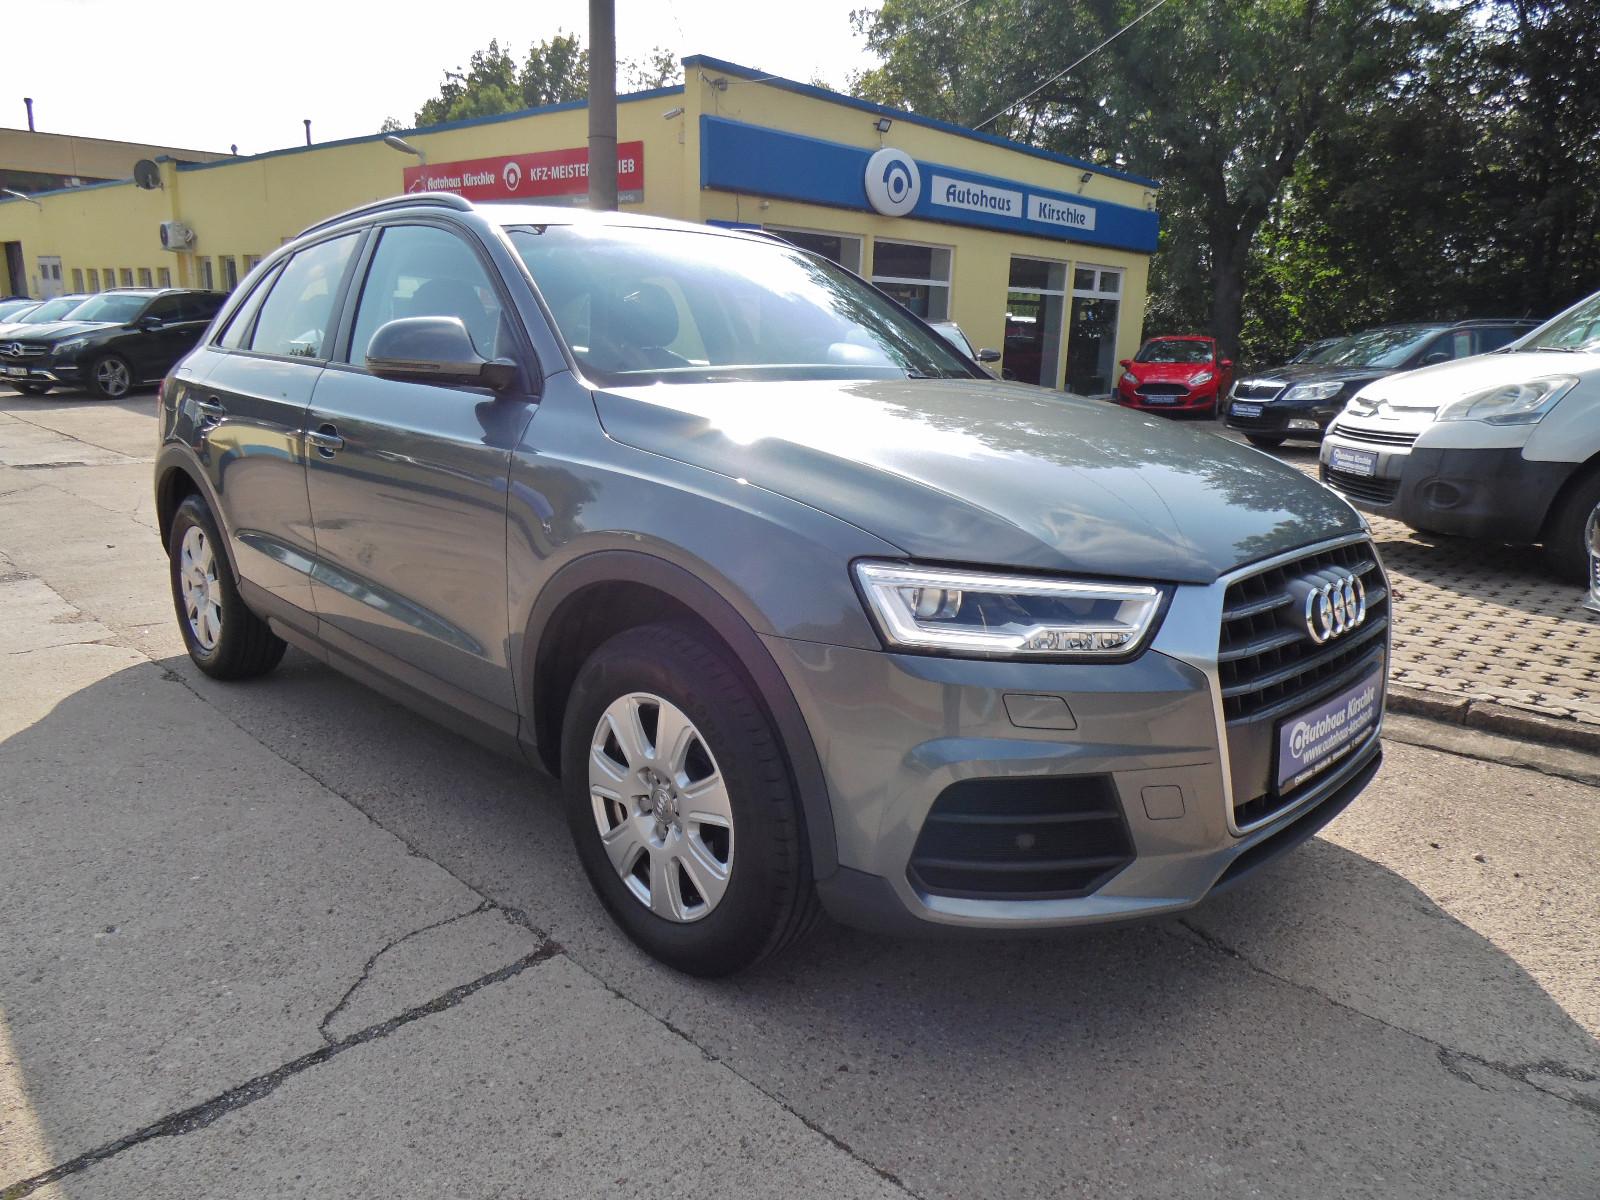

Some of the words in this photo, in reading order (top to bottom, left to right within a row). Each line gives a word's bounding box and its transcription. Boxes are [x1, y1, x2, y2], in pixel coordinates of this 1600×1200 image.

[428, 176, 461, 190] Autohaus
[463, 171, 495, 187] Kirschke
[946, 184, 1011, 212] Autohaus
[1039, 202, 1086, 225] Kirschke
[1302, 709, 1346, 749] Autohaus
